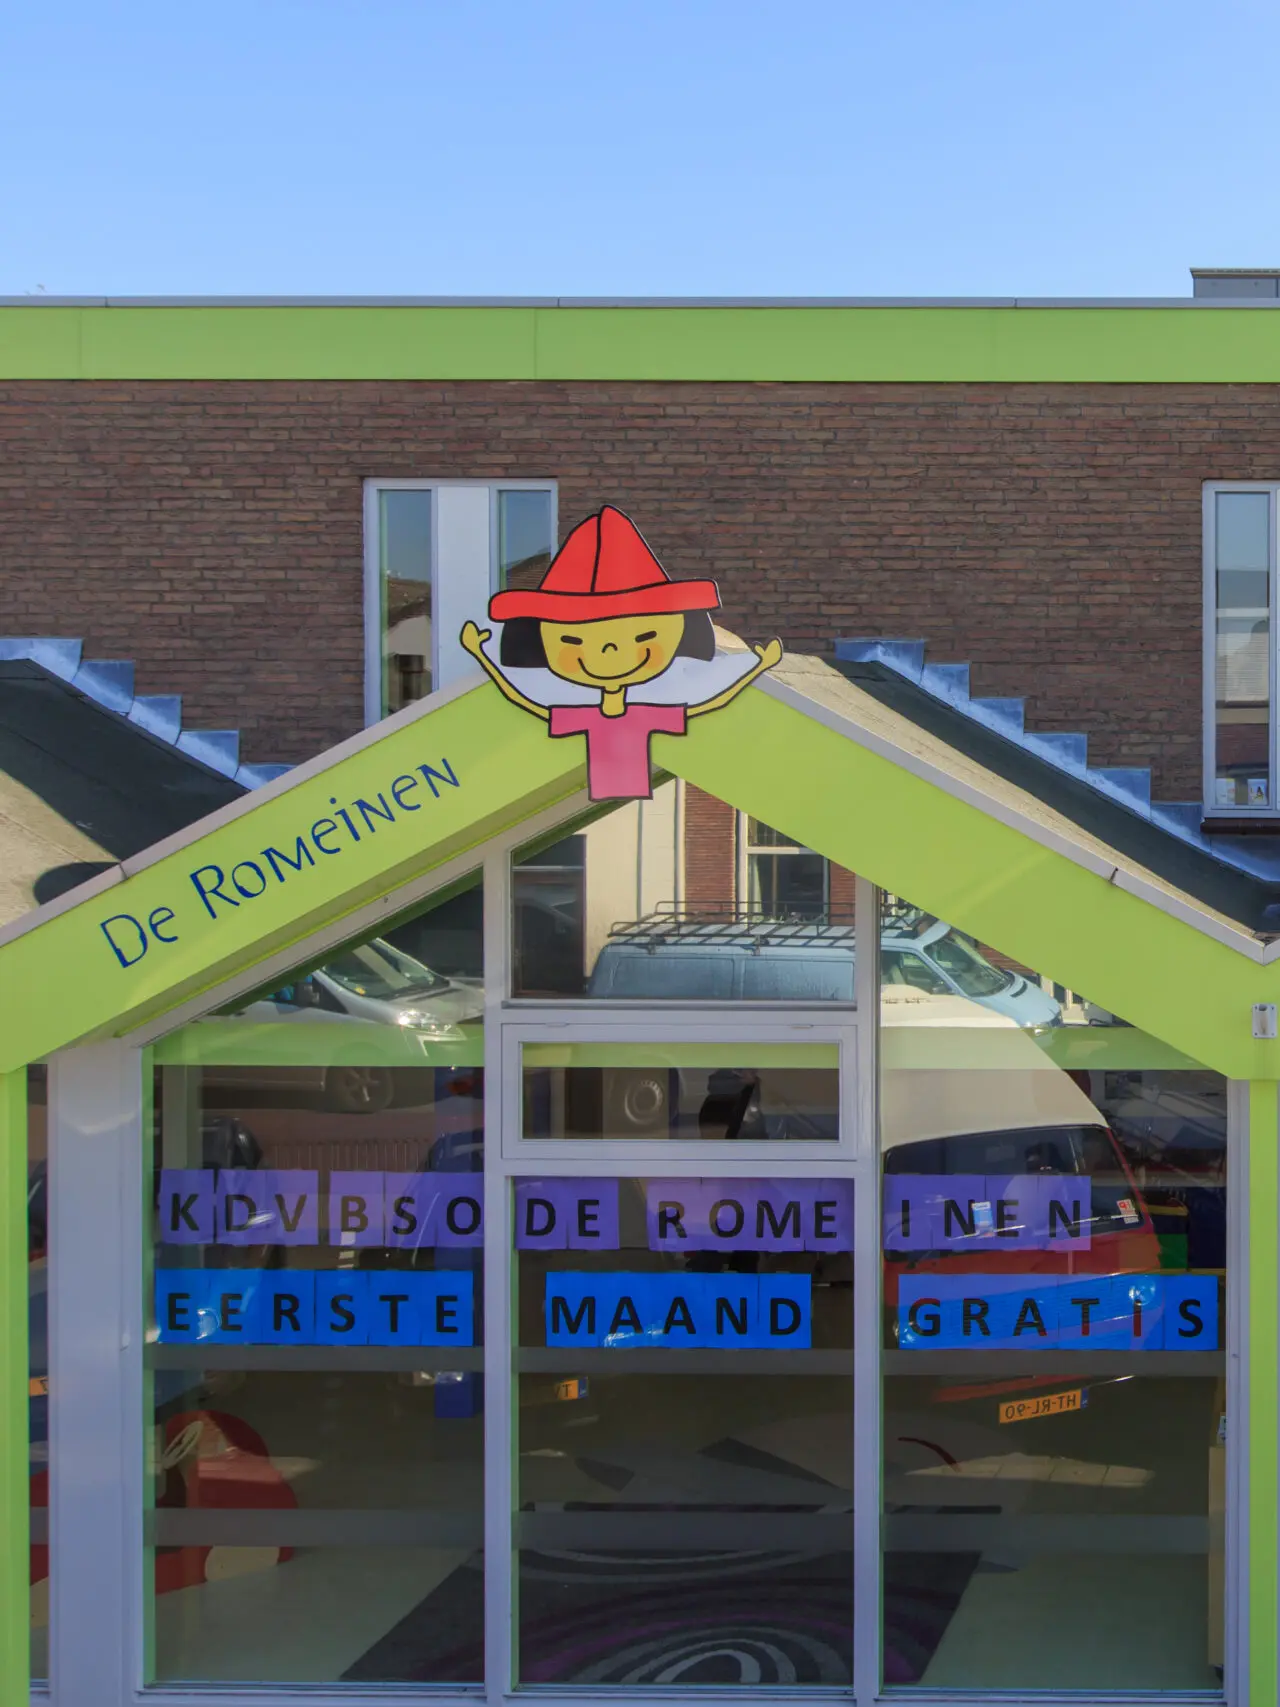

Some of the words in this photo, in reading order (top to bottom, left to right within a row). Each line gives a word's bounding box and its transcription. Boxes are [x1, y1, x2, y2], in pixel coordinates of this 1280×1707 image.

[100, 906, 179, 968] De
[525, 1198, 601, 1238] DE
[167, 1292, 459, 1334] EERSTE
[551, 1296, 803, 1336] MAAND
[907, 1298, 1205, 1338] GRATIS
